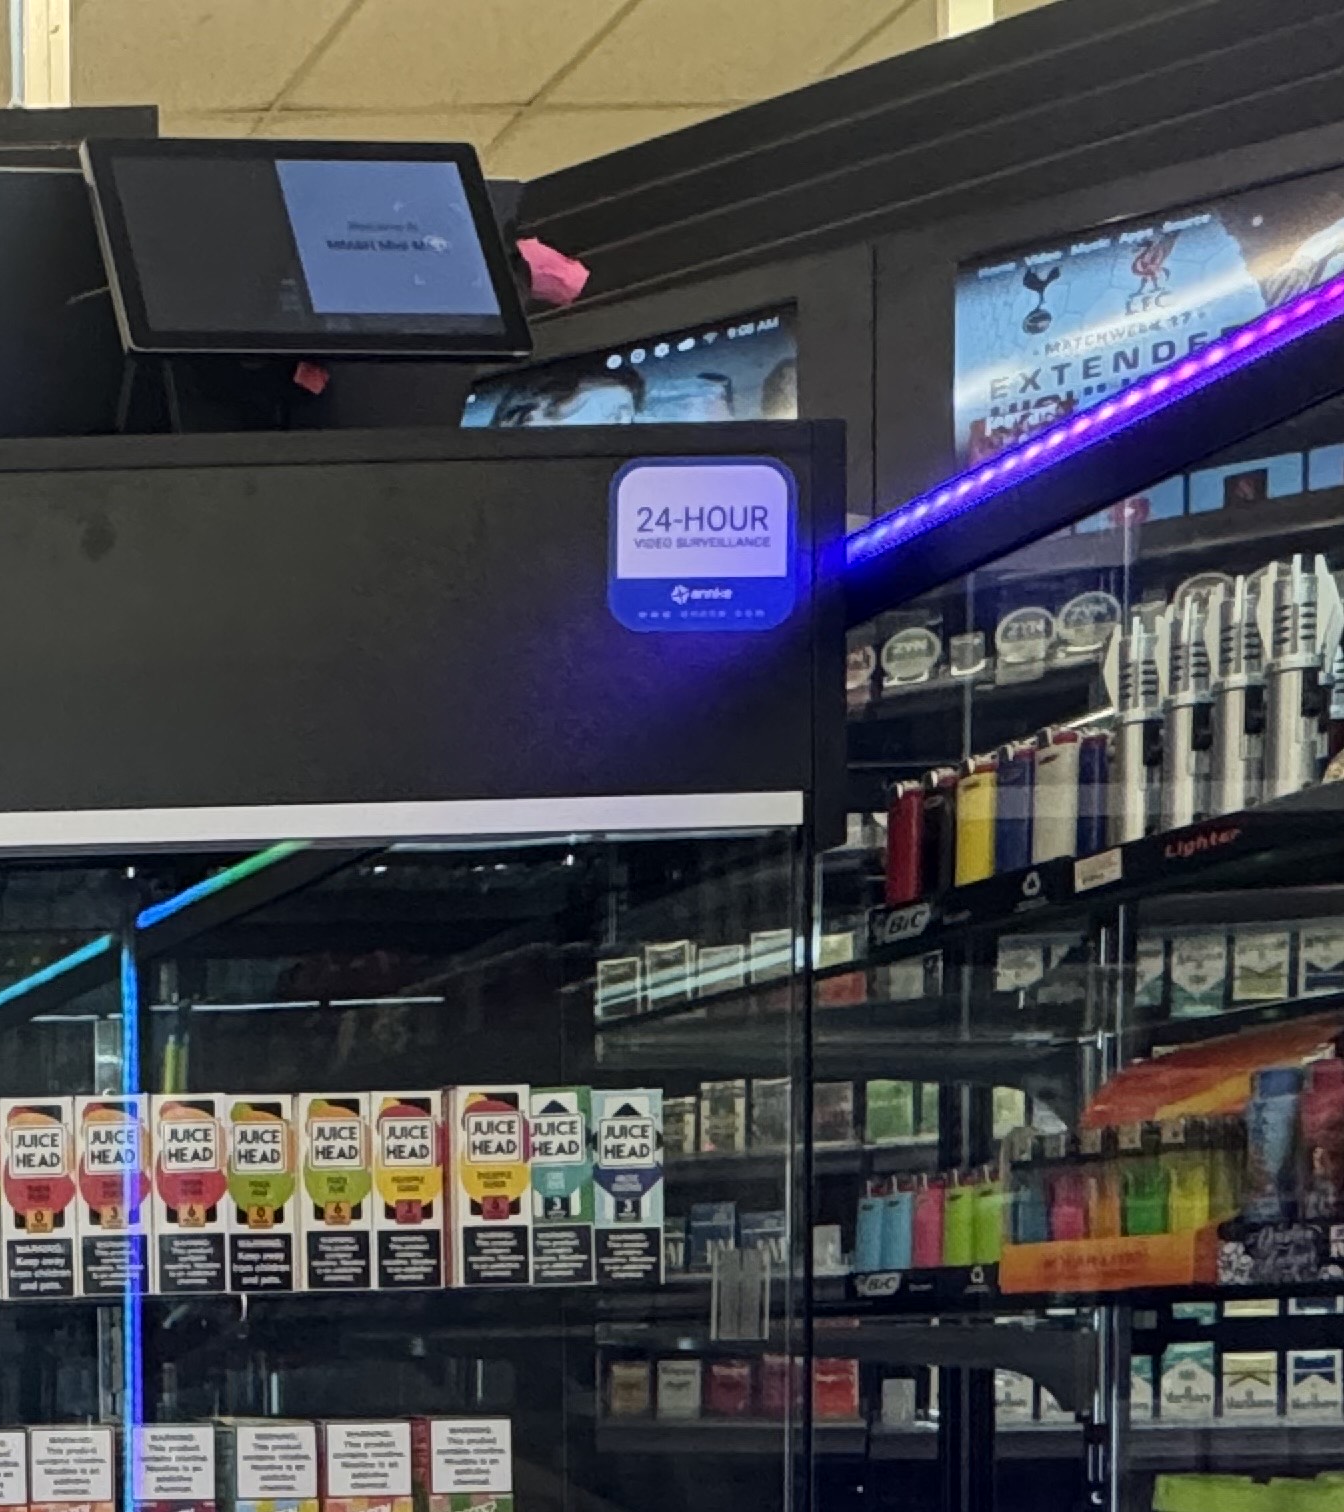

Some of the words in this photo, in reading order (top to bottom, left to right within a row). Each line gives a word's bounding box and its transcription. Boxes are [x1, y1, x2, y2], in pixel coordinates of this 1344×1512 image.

[1125, 291, 1171, 315] LFC
[990, 325, 1239, 401] EXTENDE
[636, 505, 769, 532] 24-HOUR
[634, 537, 672, 549] VIDEO
[676, 536, 771, 548] SURVEILLANCE
[1164, 826, 1241, 859] Lighter
[15, 1129, 60, 1149] JUICE
[166, 1126, 213, 1144] JUICE
[236, 1128, 281, 1146] JUICE
[313, 1127, 358, 1145] JUICE
[469, 1120, 516, 1139] JUICE
[603, 1125, 650, 1143] JUICE
[168, 1145, 214, 1164] HEAD
[236, 1147, 281, 1165] HEAD
[314, 1144, 358, 1162] HEAD
[470, 1138, 516, 1157] HEAD
[605, 1142, 651, 1161] HEAD
[16, 1150, 61, 1169] HEAD
